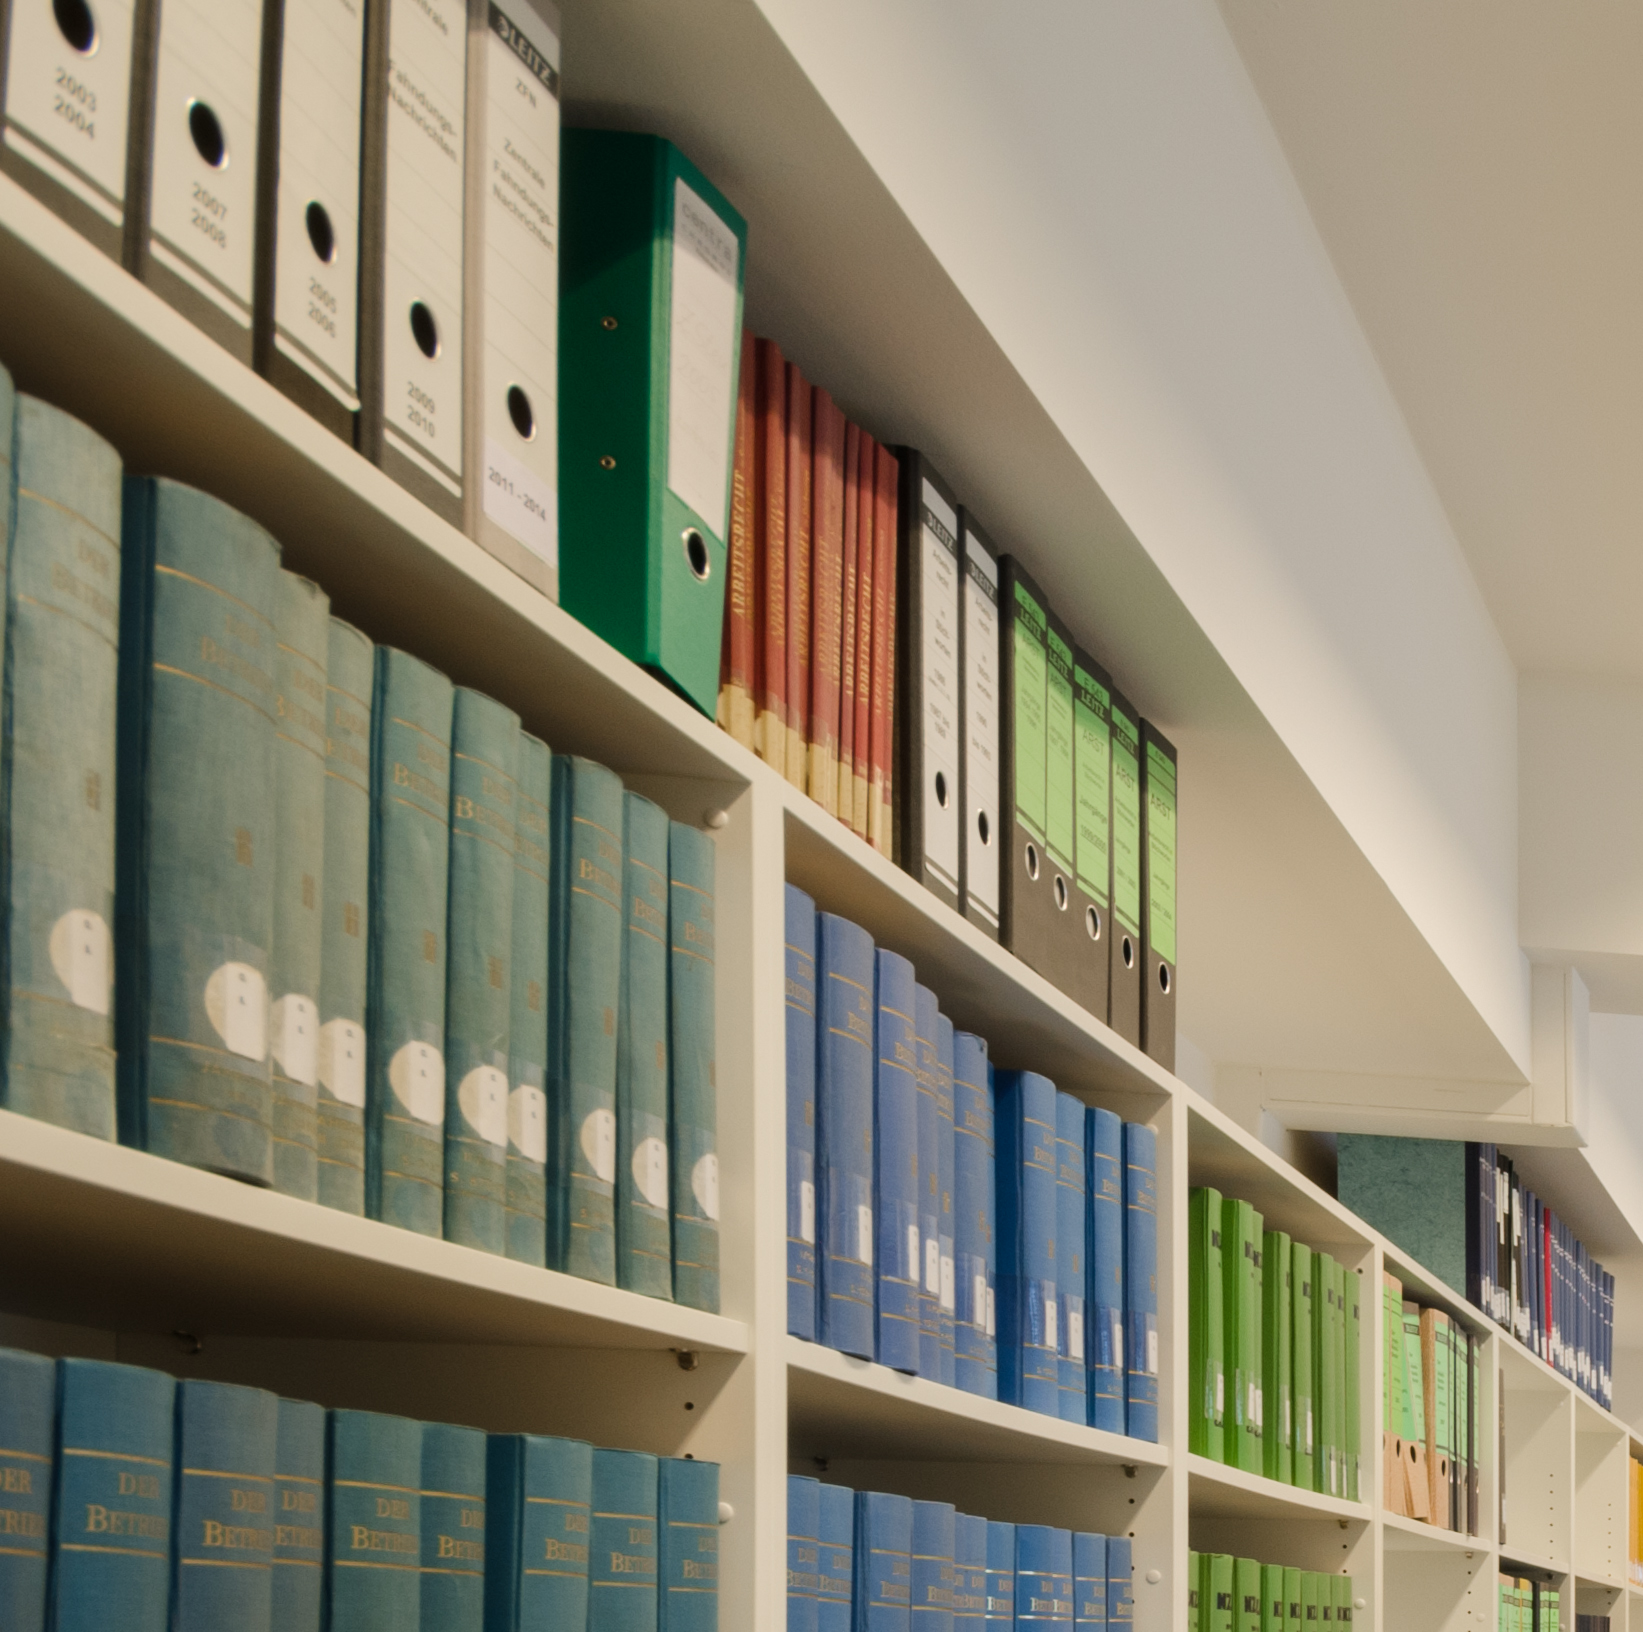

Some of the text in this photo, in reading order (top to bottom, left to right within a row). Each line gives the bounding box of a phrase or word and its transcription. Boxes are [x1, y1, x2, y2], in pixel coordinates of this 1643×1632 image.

[507, 30, 554, 87] LEITZ
[55, 66, 97, 113] 2003
[53, 95, 95, 140] 2004
[503, 138, 546, 190] Zentrale
[192, 181, 228, 221] 2007
[492, 158, 555, 228] Fahndungs-
[191, 207, 227, 250] 2008
[492, 184, 555, 254] Nachrichten
[308, 276, 338, 315] 2005
[308, 301, 337, 339] 2006
[406, 379, 437, 415] 2009
[406, 404, 437, 439] 2010
[488, 466, 514, 496] 2011
[523, 493, 546, 522] 2014
[1080, 688, 1105, 720] LEITZ
